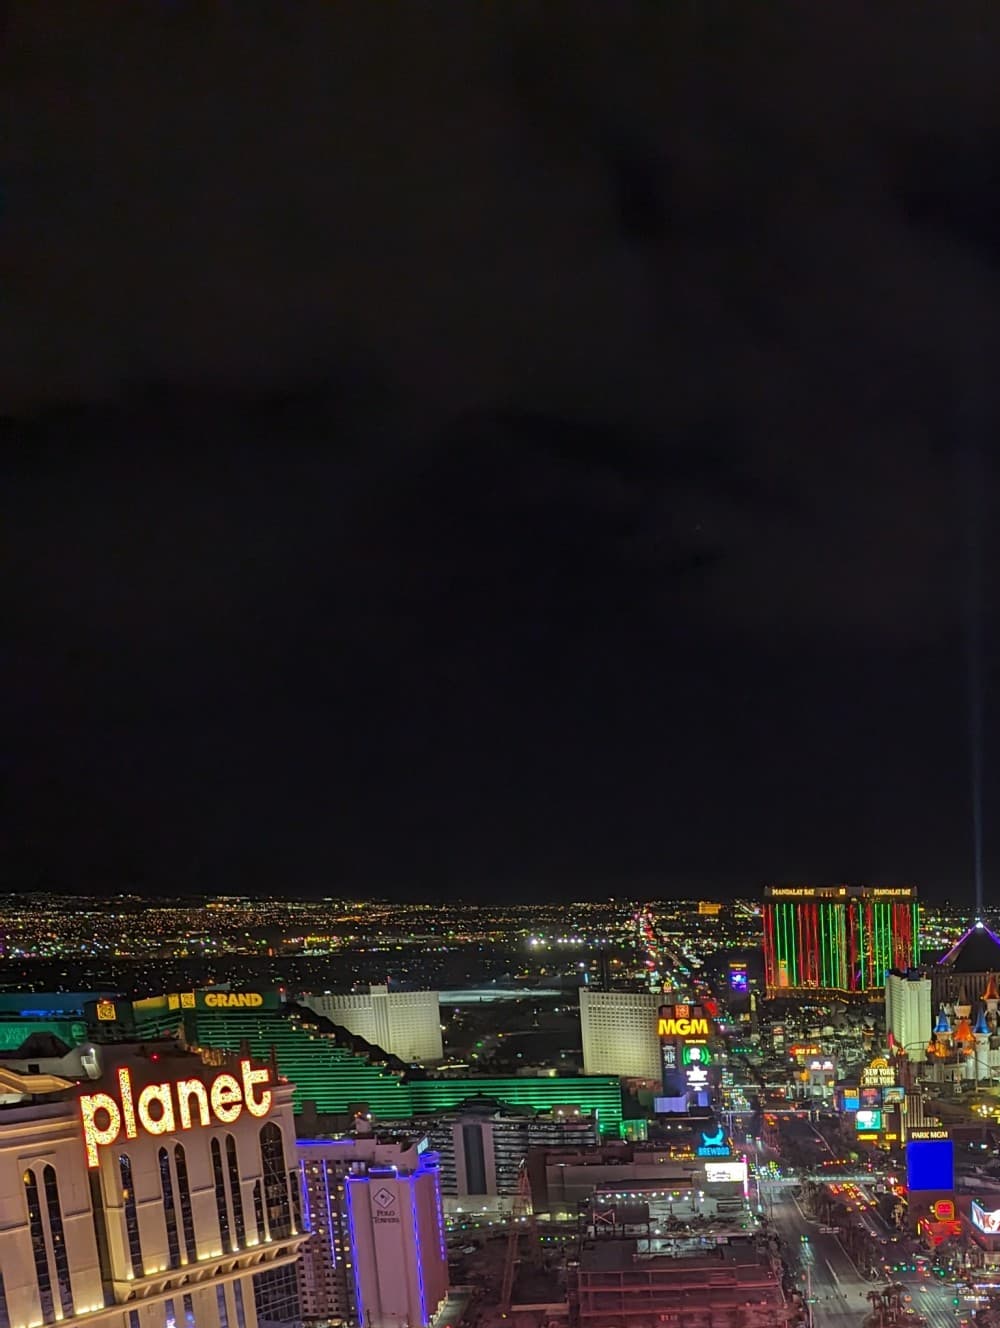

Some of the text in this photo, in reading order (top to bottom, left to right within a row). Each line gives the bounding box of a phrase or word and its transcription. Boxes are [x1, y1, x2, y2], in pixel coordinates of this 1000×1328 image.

[204, 992, 263, 1008] GRAND
[658, 1018, 709, 1036] MGM
[863, 1067, 895, 1075] NEW YORK
[79, 1060, 273, 1168] planet
[911, 1131, 930, 1139] PARK
